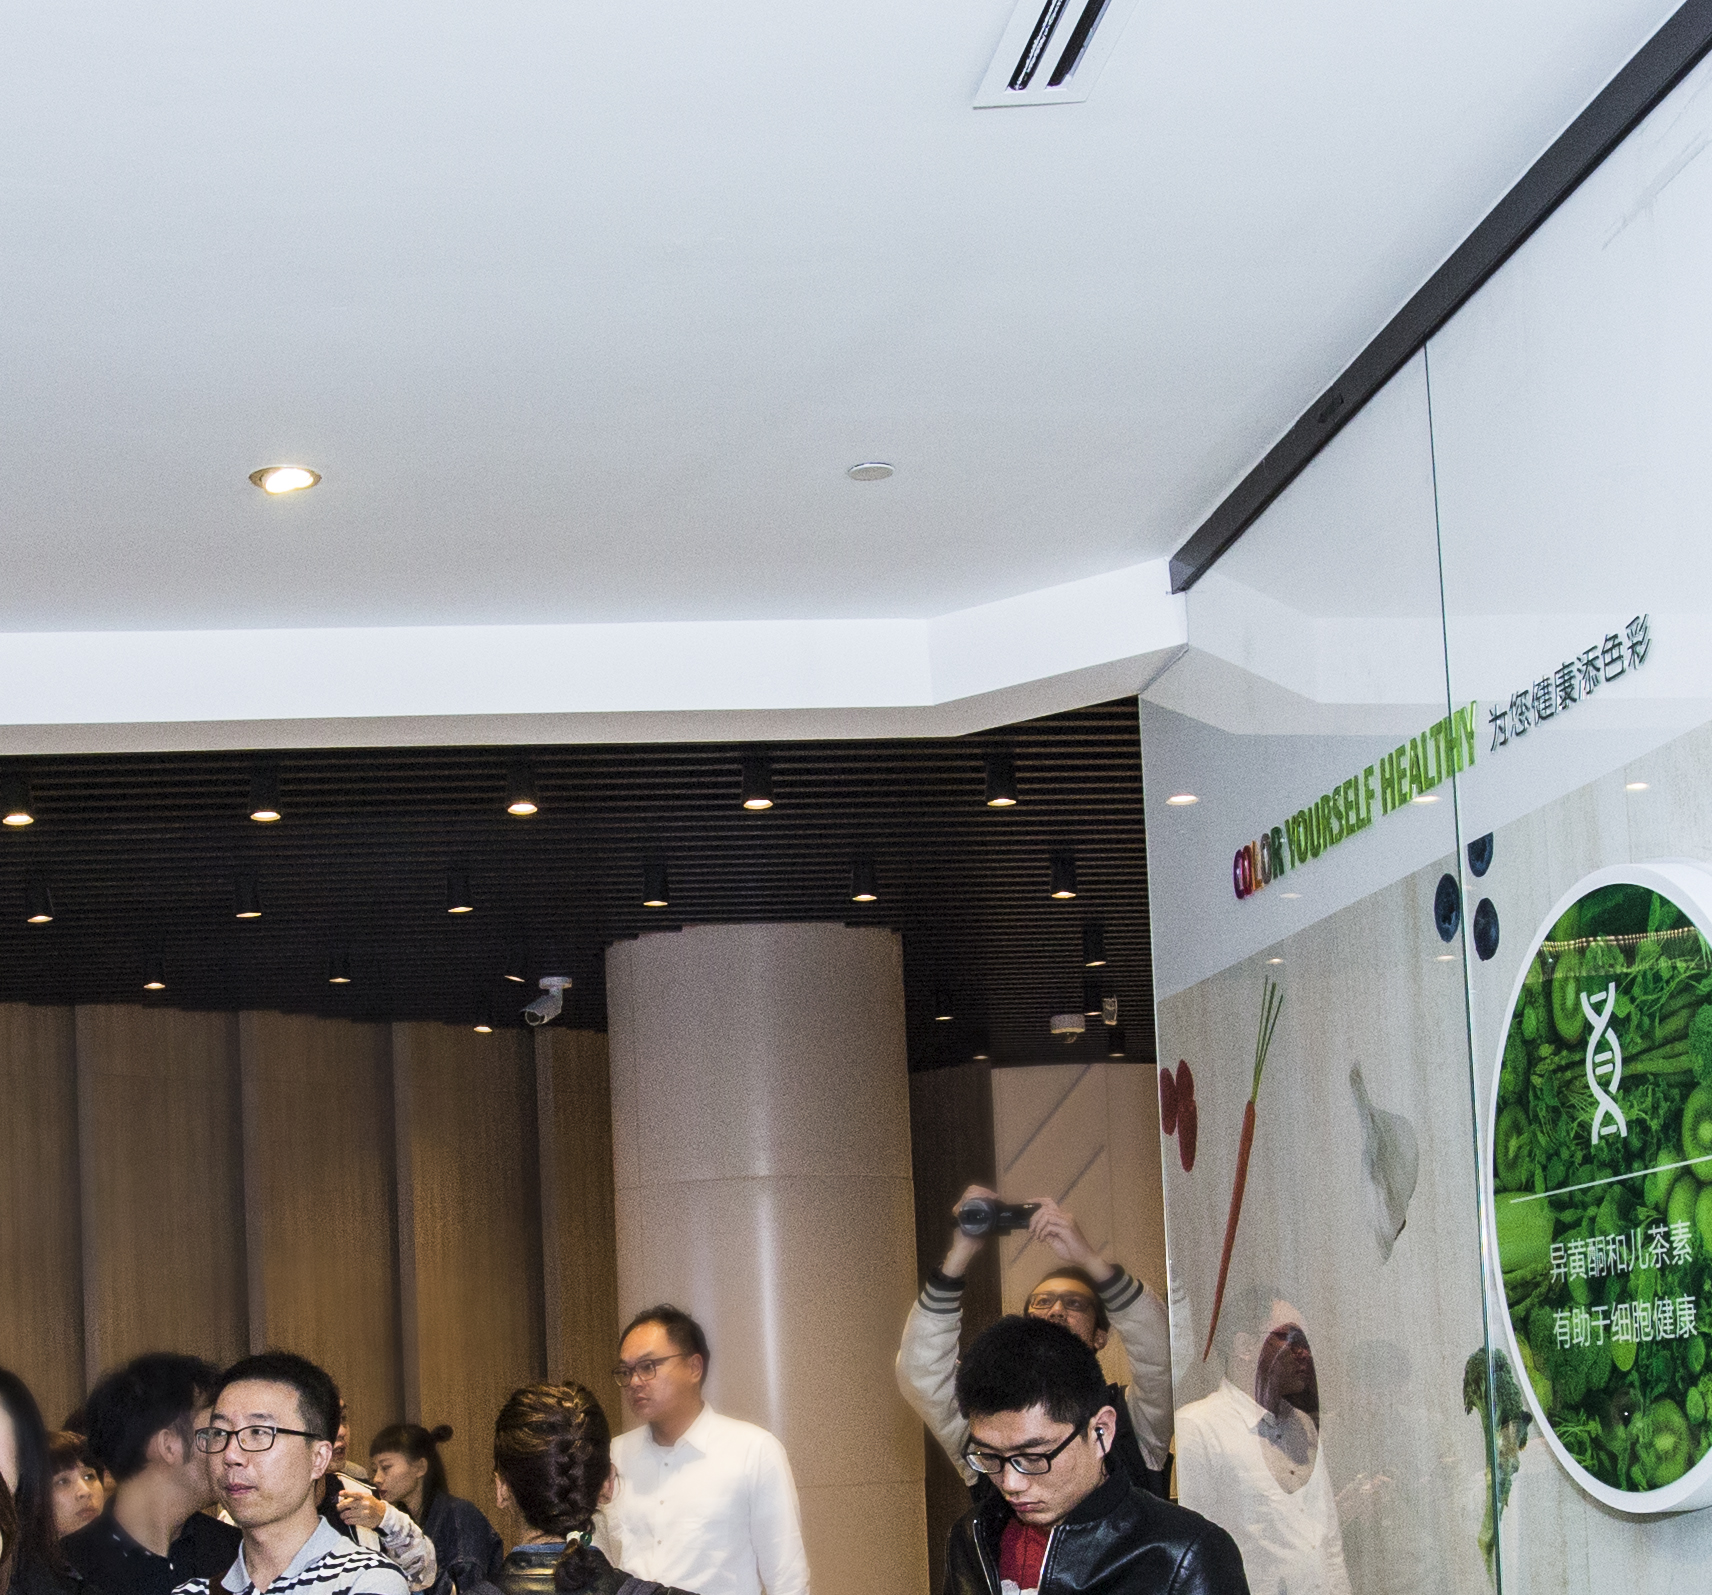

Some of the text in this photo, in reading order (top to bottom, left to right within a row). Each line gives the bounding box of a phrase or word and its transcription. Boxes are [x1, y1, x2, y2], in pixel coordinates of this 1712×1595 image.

[1489, 614, 1651, 752] 为您健康添色彩
[1233, 700, 1477, 899] COLOR YOURSELF HEALTHY
[1550, 1220, 1692, 1284] 异黄酮和儿茶素
[1553, 1293, 1698, 1350] 有助于细胞健康
